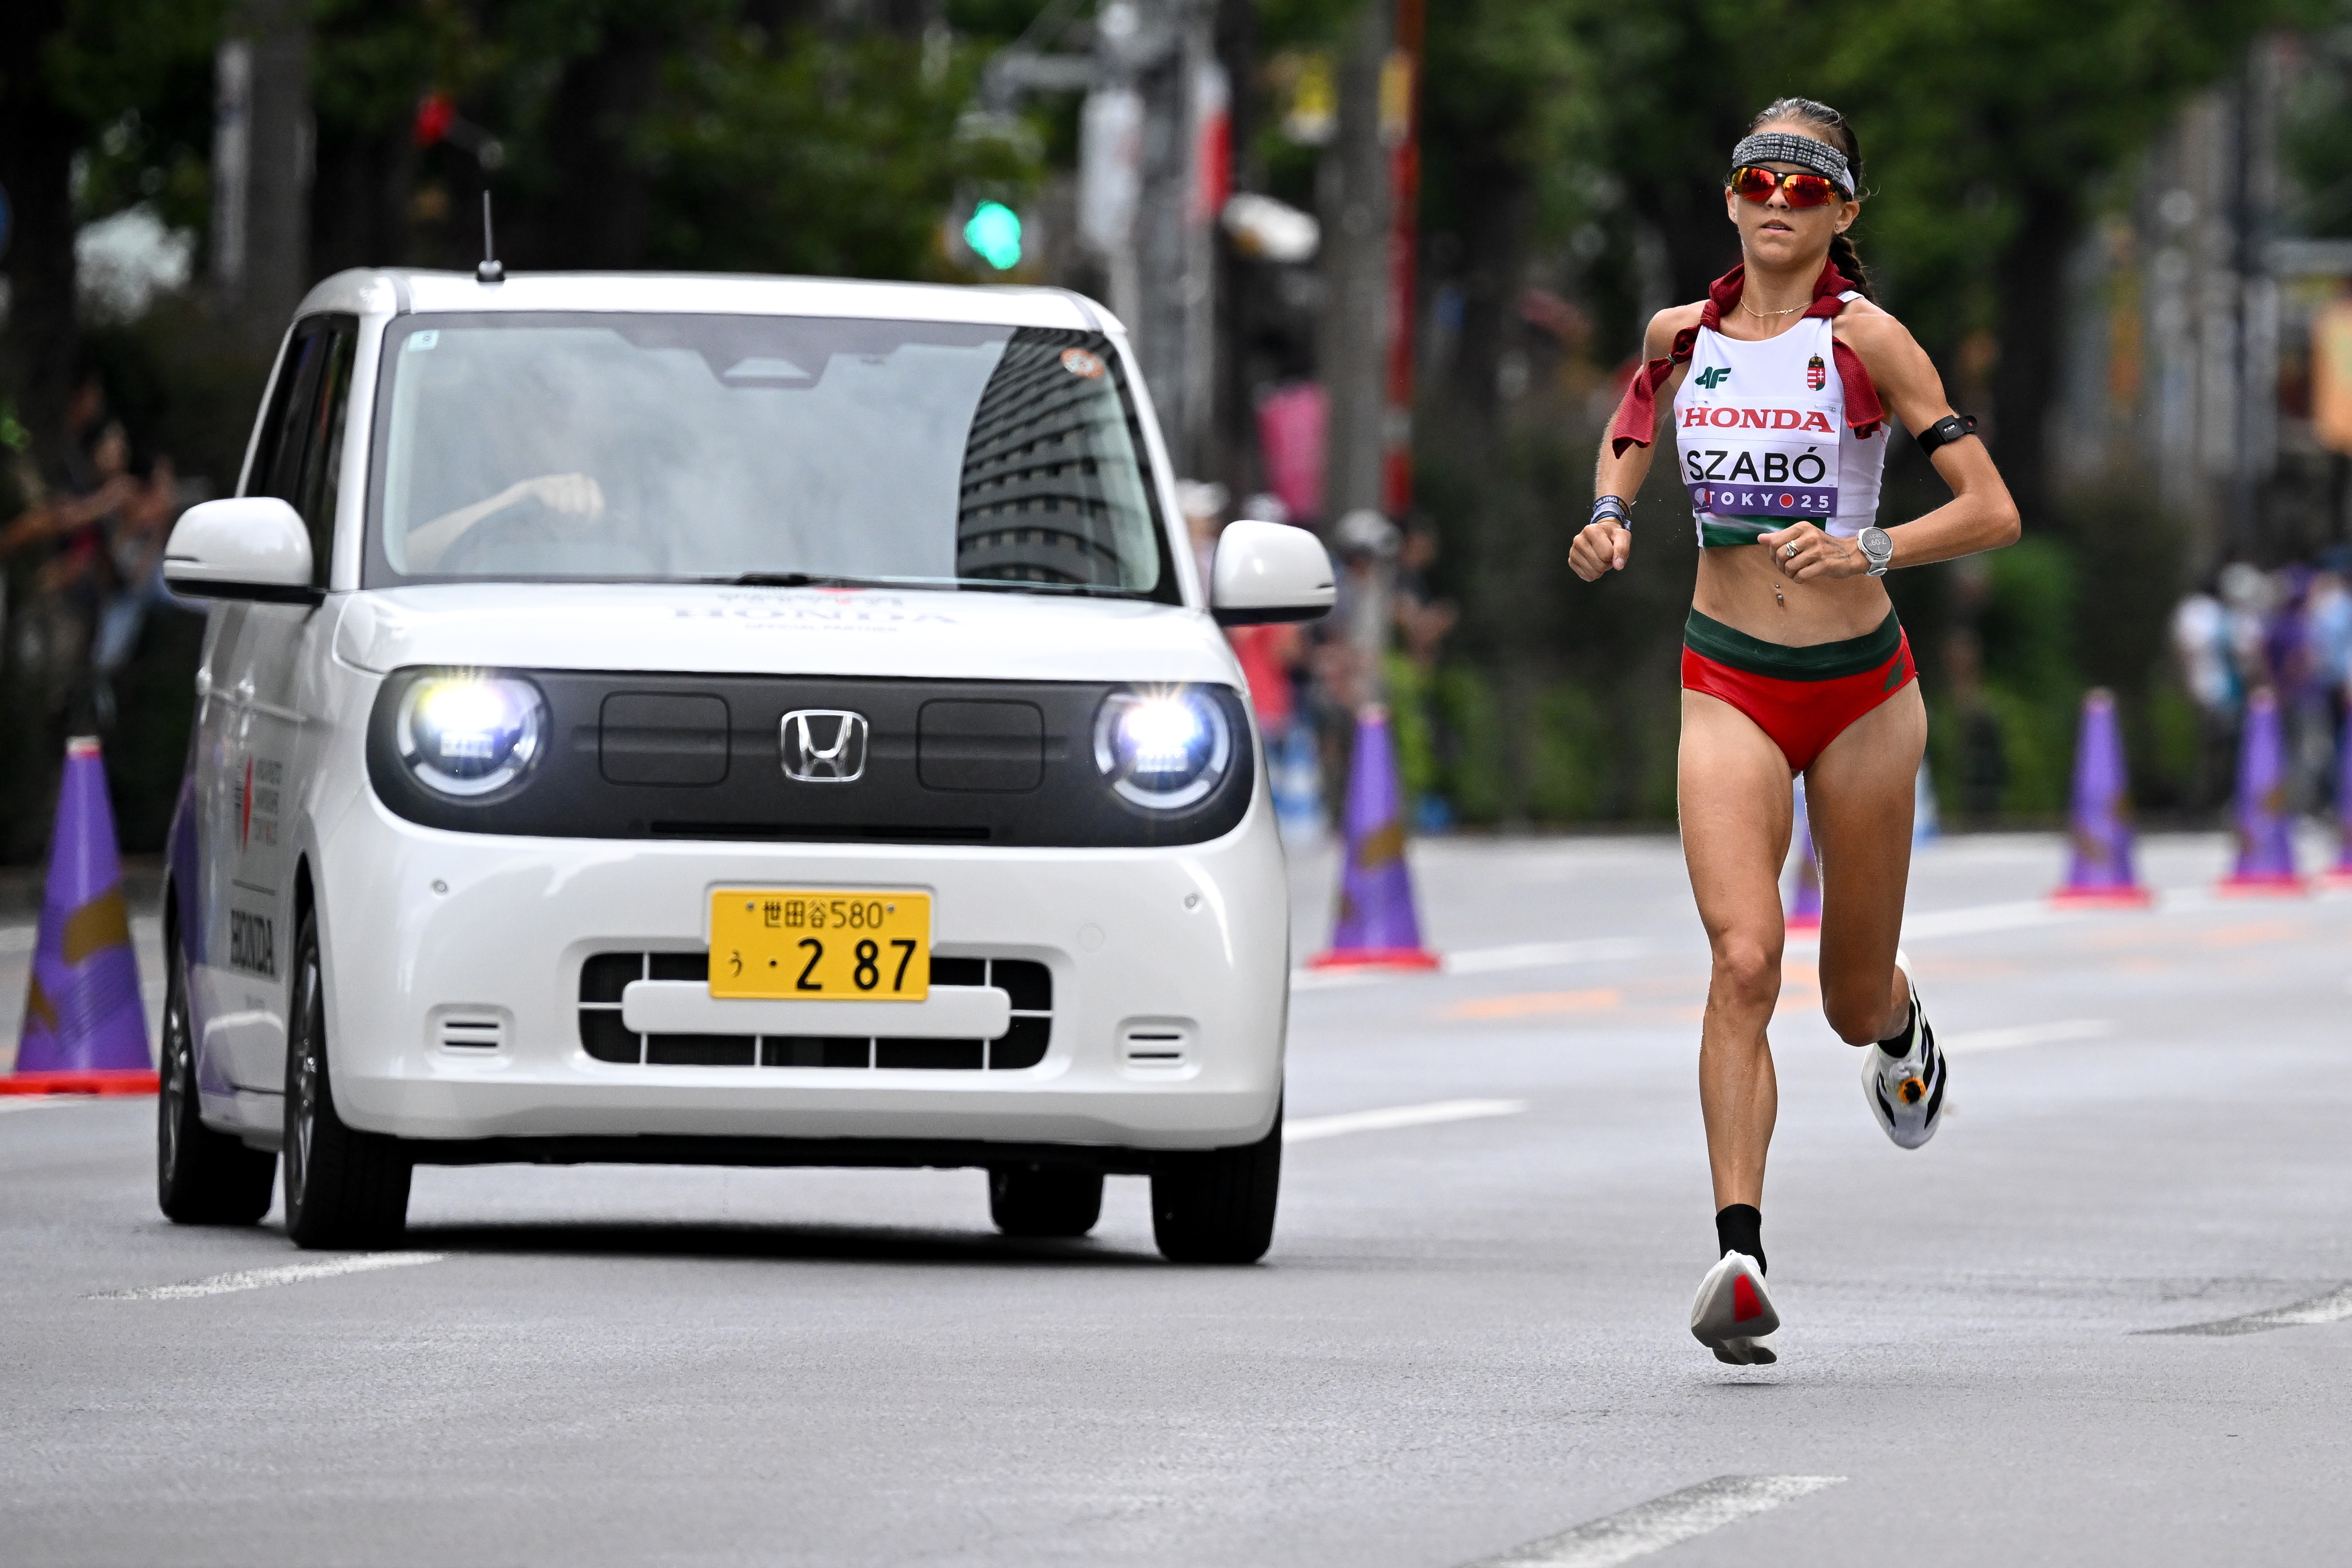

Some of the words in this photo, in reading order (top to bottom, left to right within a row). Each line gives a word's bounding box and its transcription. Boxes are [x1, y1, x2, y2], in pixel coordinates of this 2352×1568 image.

[1682, 407, 1835, 433] HONDA
[1687, 446, 1826, 484] SZABÓ
[673, 607, 958, 624] HONDA
[728, 950, 744, 978] う
